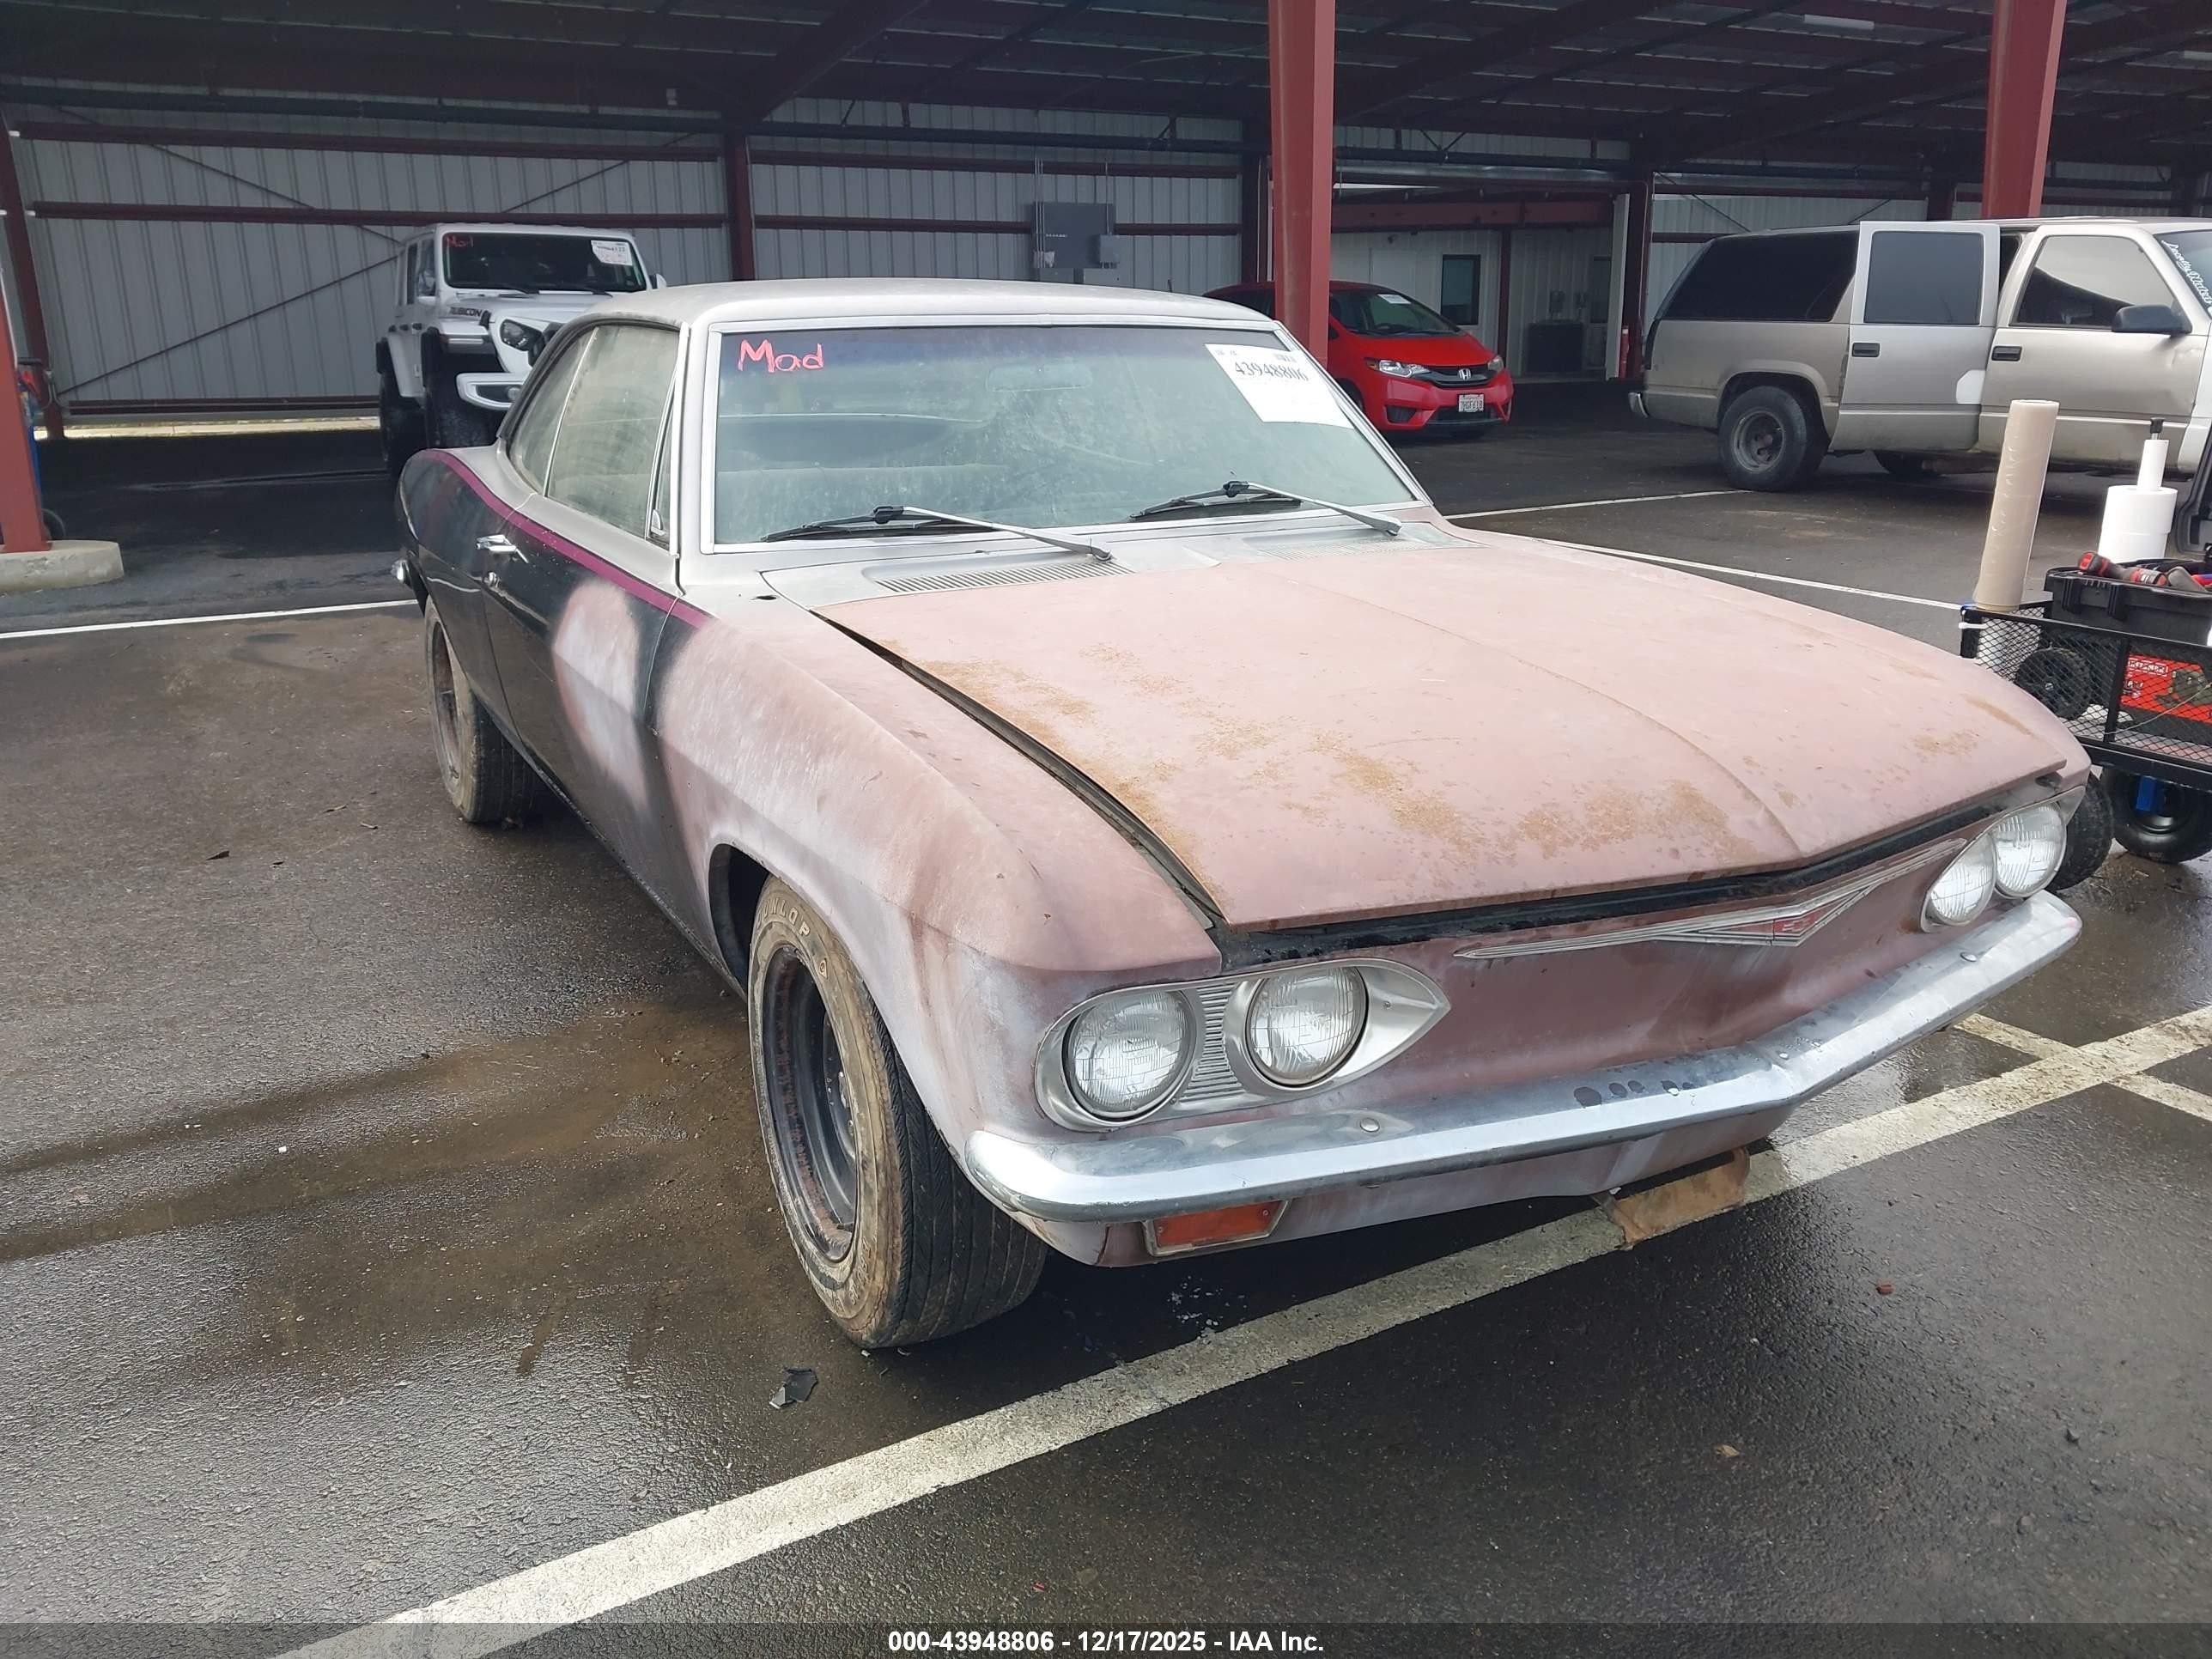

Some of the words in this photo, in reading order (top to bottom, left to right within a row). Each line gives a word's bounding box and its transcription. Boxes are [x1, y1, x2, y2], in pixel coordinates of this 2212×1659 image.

[738, 339, 823, 373] Mod
[1234, 361, 1310, 381] 43948806
[756, 897, 811, 937] DUNLOP
